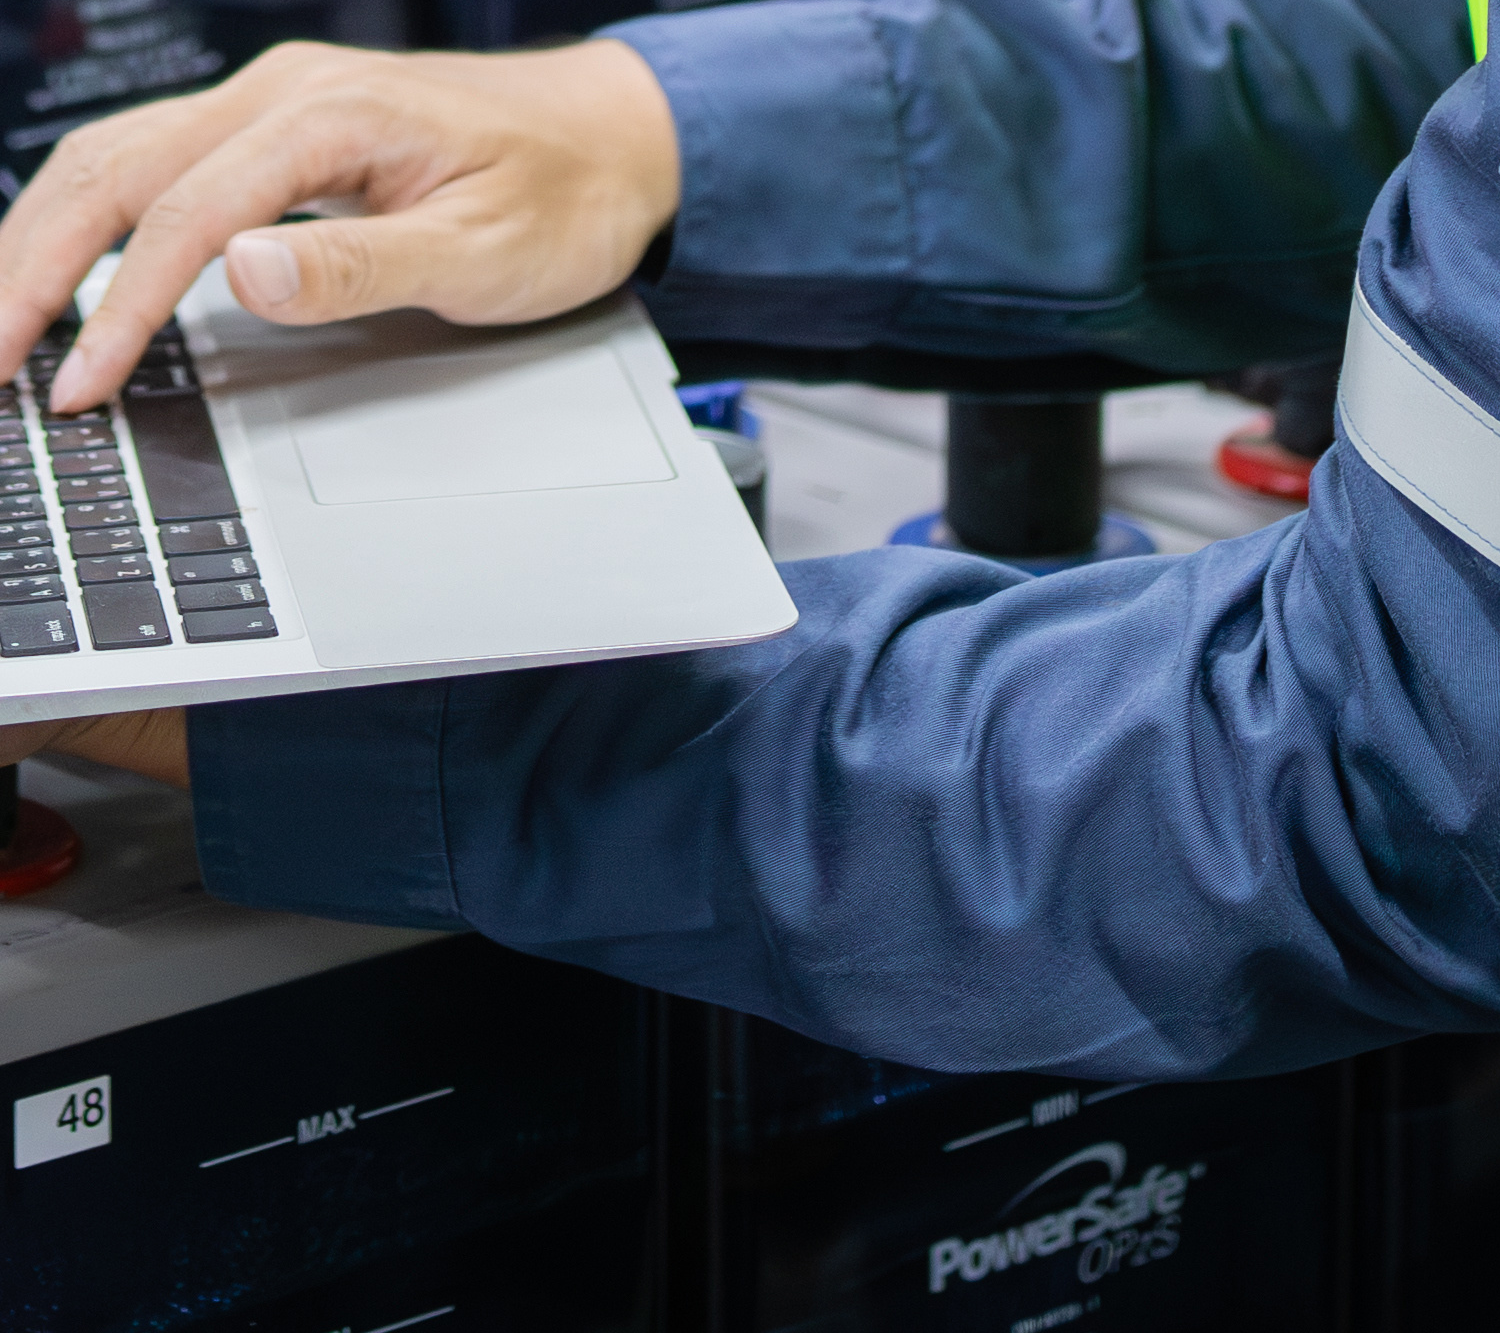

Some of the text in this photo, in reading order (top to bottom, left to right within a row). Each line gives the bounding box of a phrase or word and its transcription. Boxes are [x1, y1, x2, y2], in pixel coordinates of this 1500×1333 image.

[57, 1086, 106, 1134] 48
[297, 1105, 356, 1144] MAX
[928, 1163, 1189, 1294] PowerSafe
